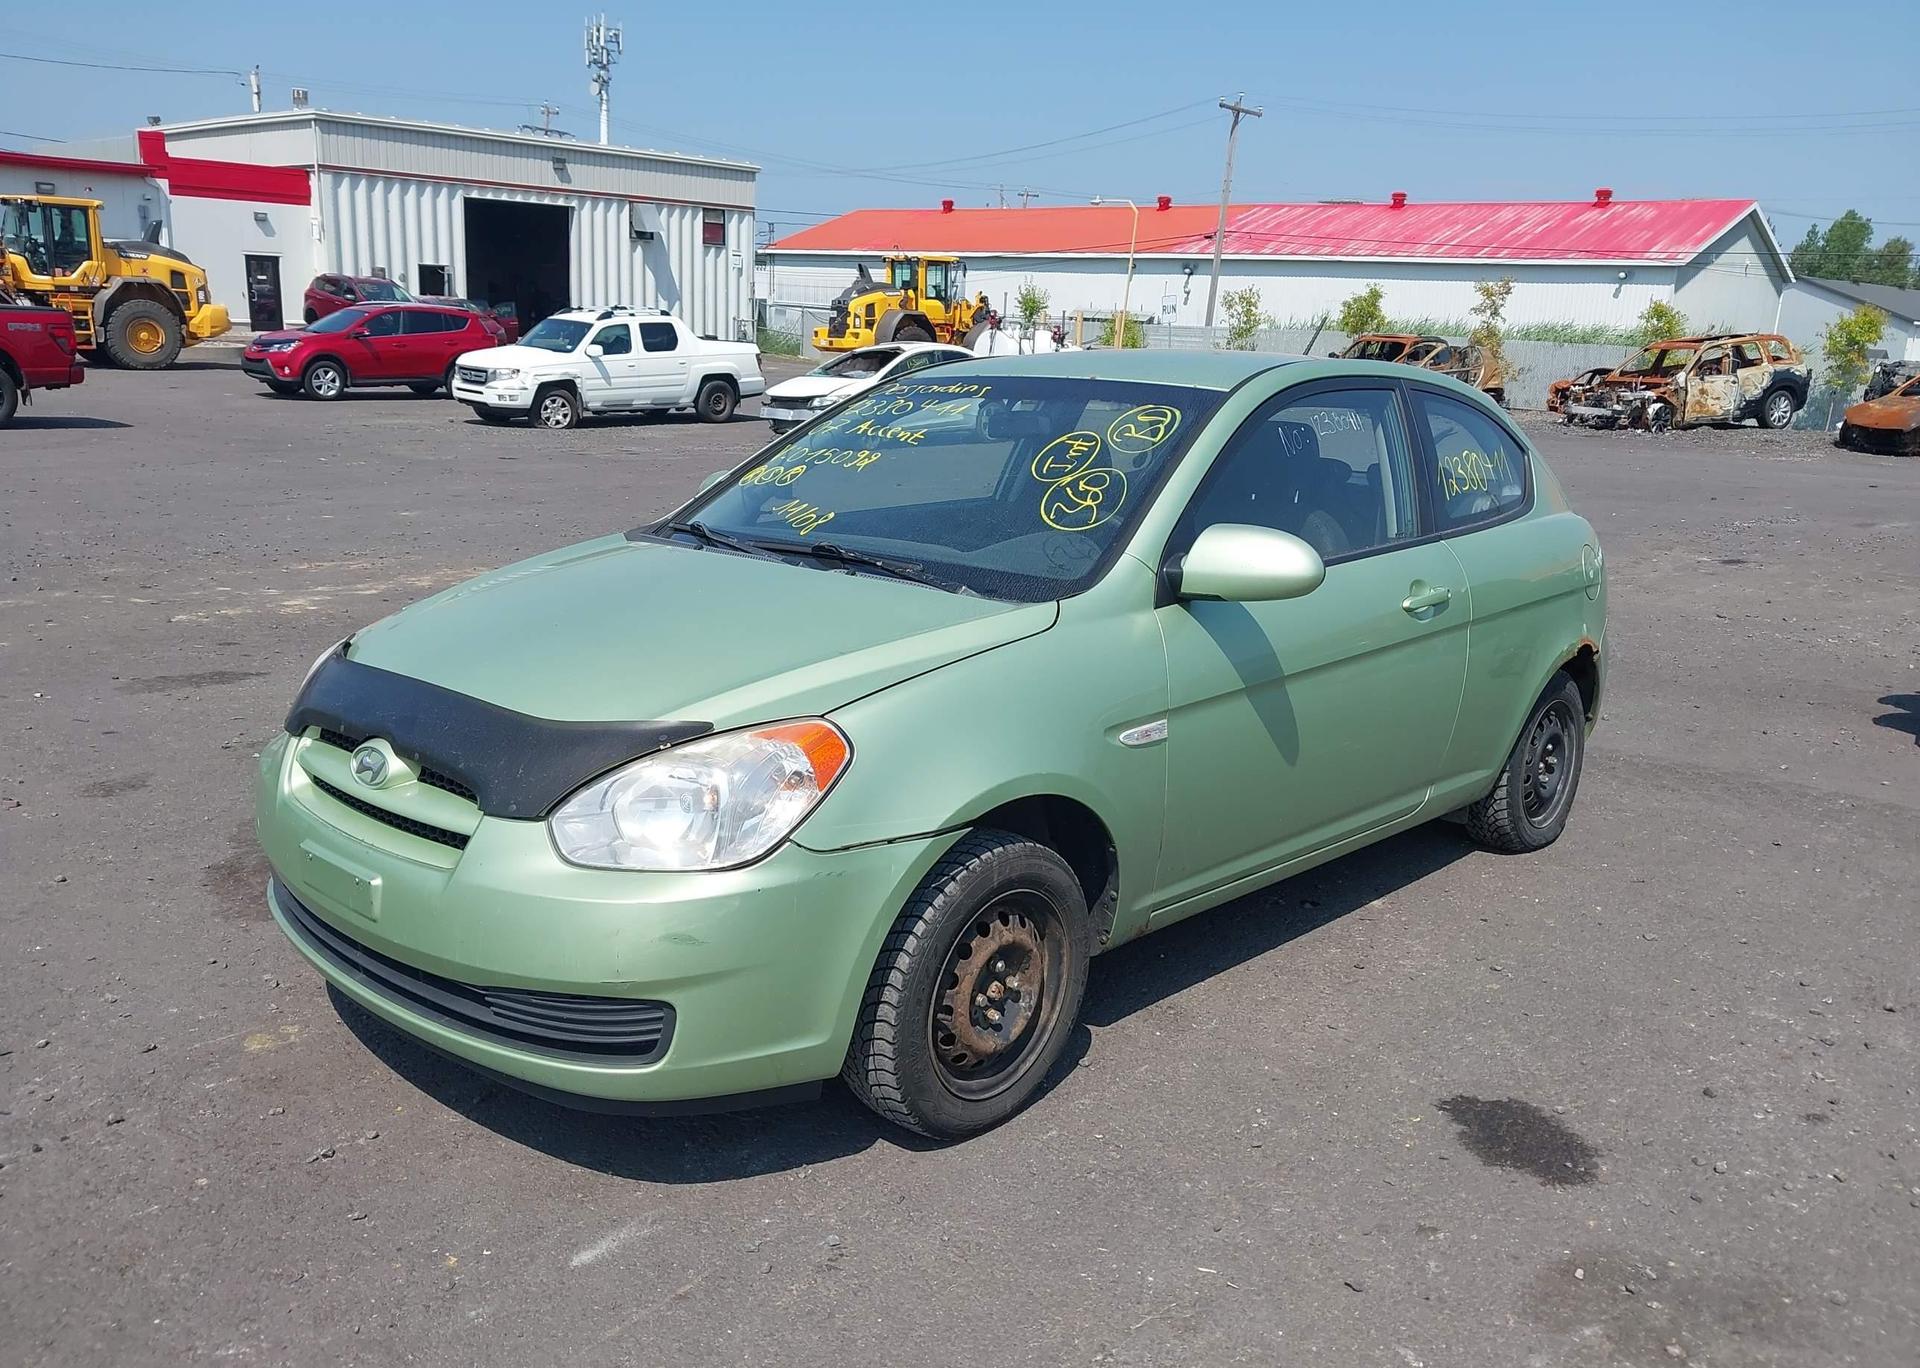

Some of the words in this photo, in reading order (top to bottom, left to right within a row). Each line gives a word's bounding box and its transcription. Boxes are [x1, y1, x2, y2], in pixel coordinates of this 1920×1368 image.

[1162, 304, 1177, 315] RUN
[846, 418, 929, 446] Accent
[1437, 443, 1514, 501] 12380411
